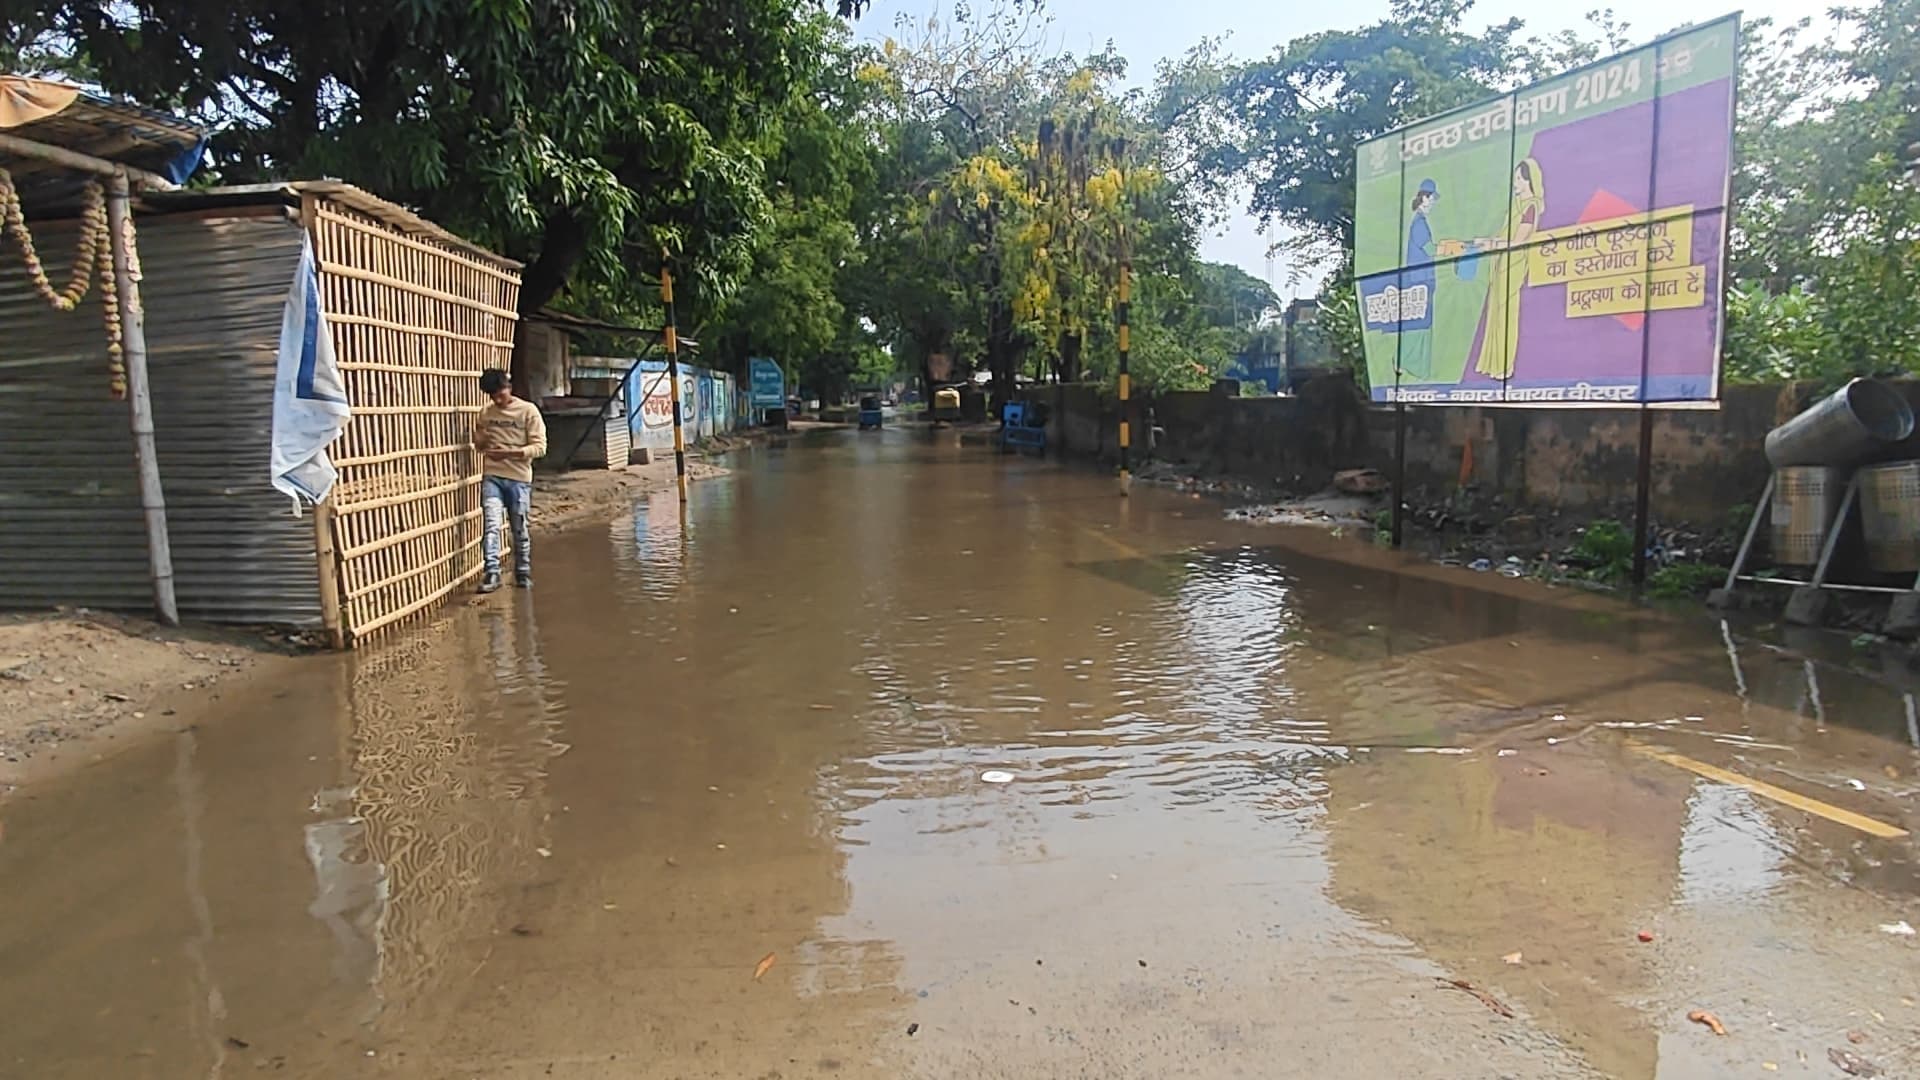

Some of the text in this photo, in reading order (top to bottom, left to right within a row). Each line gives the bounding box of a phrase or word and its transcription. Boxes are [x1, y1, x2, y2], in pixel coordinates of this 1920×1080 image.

[1576, 59, 1641, 108] 2024
[1547, 240, 1675, 277] का इस्तेमाल करें
[1570, 272, 1699, 309] प्रदूषण को मात दें
